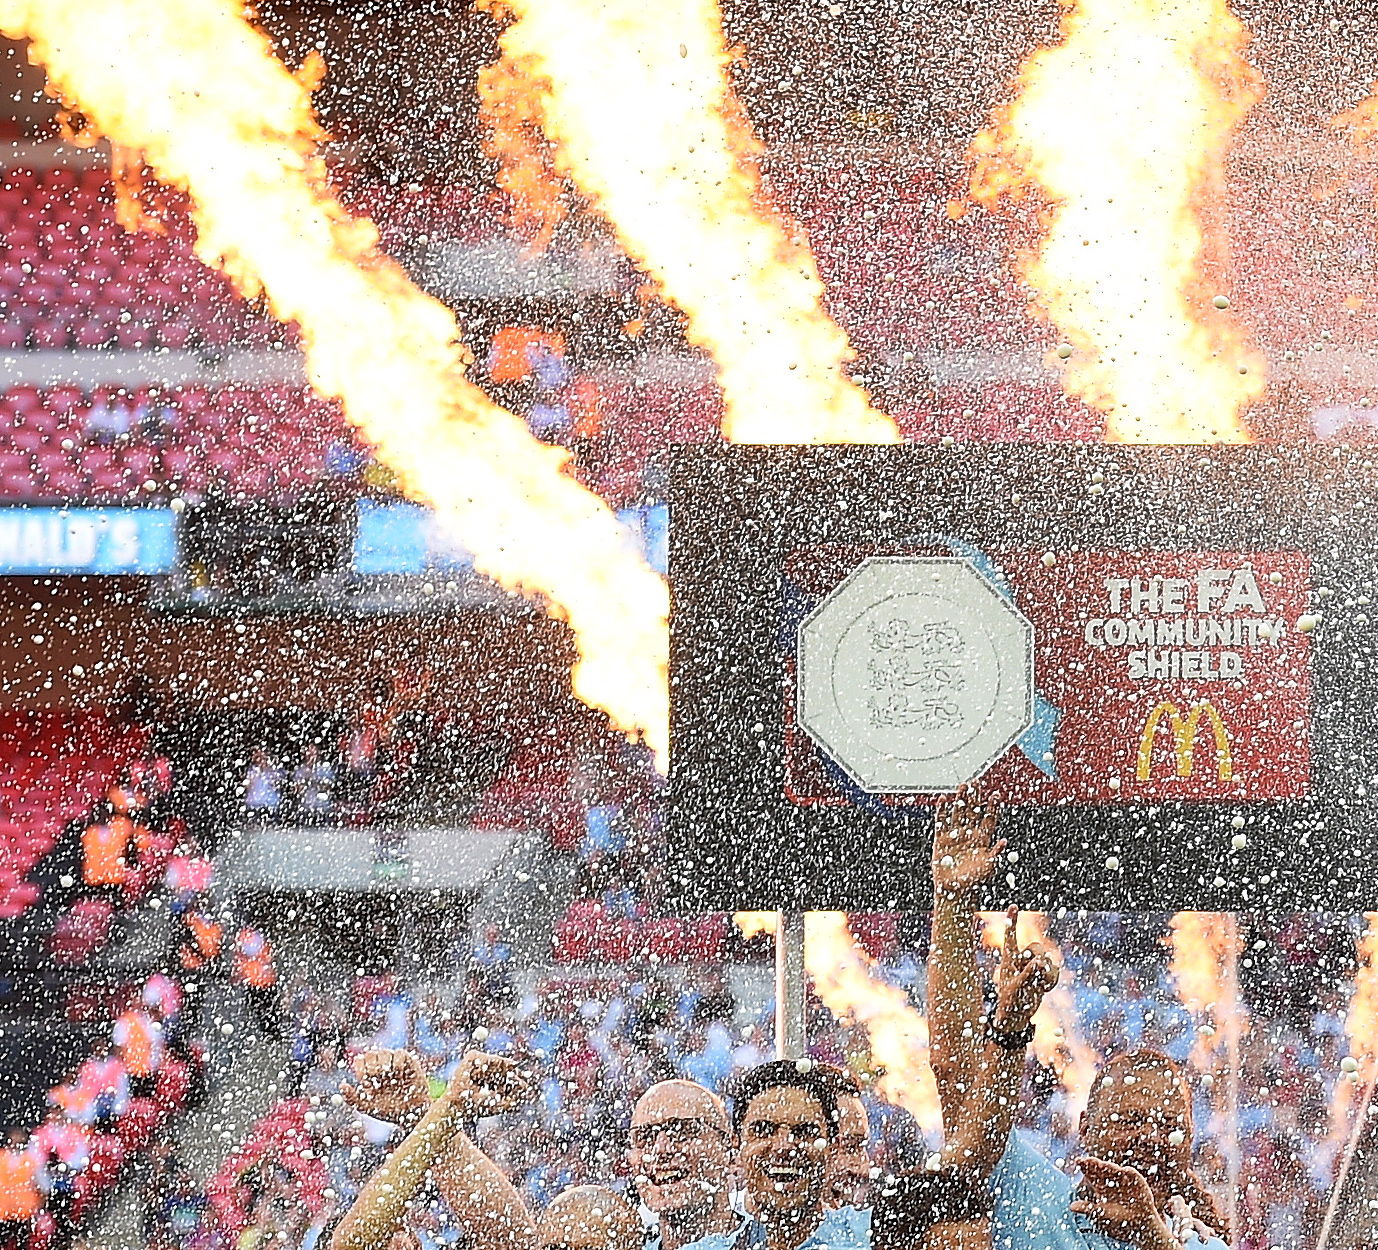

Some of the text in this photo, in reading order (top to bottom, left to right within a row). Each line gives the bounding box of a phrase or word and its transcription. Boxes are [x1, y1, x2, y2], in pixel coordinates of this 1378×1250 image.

[1105, 568, 1267, 613] THE FA
[1084, 618, 1286, 648] COMMUNITY
[1129, 651, 1244, 679] SHIELD
